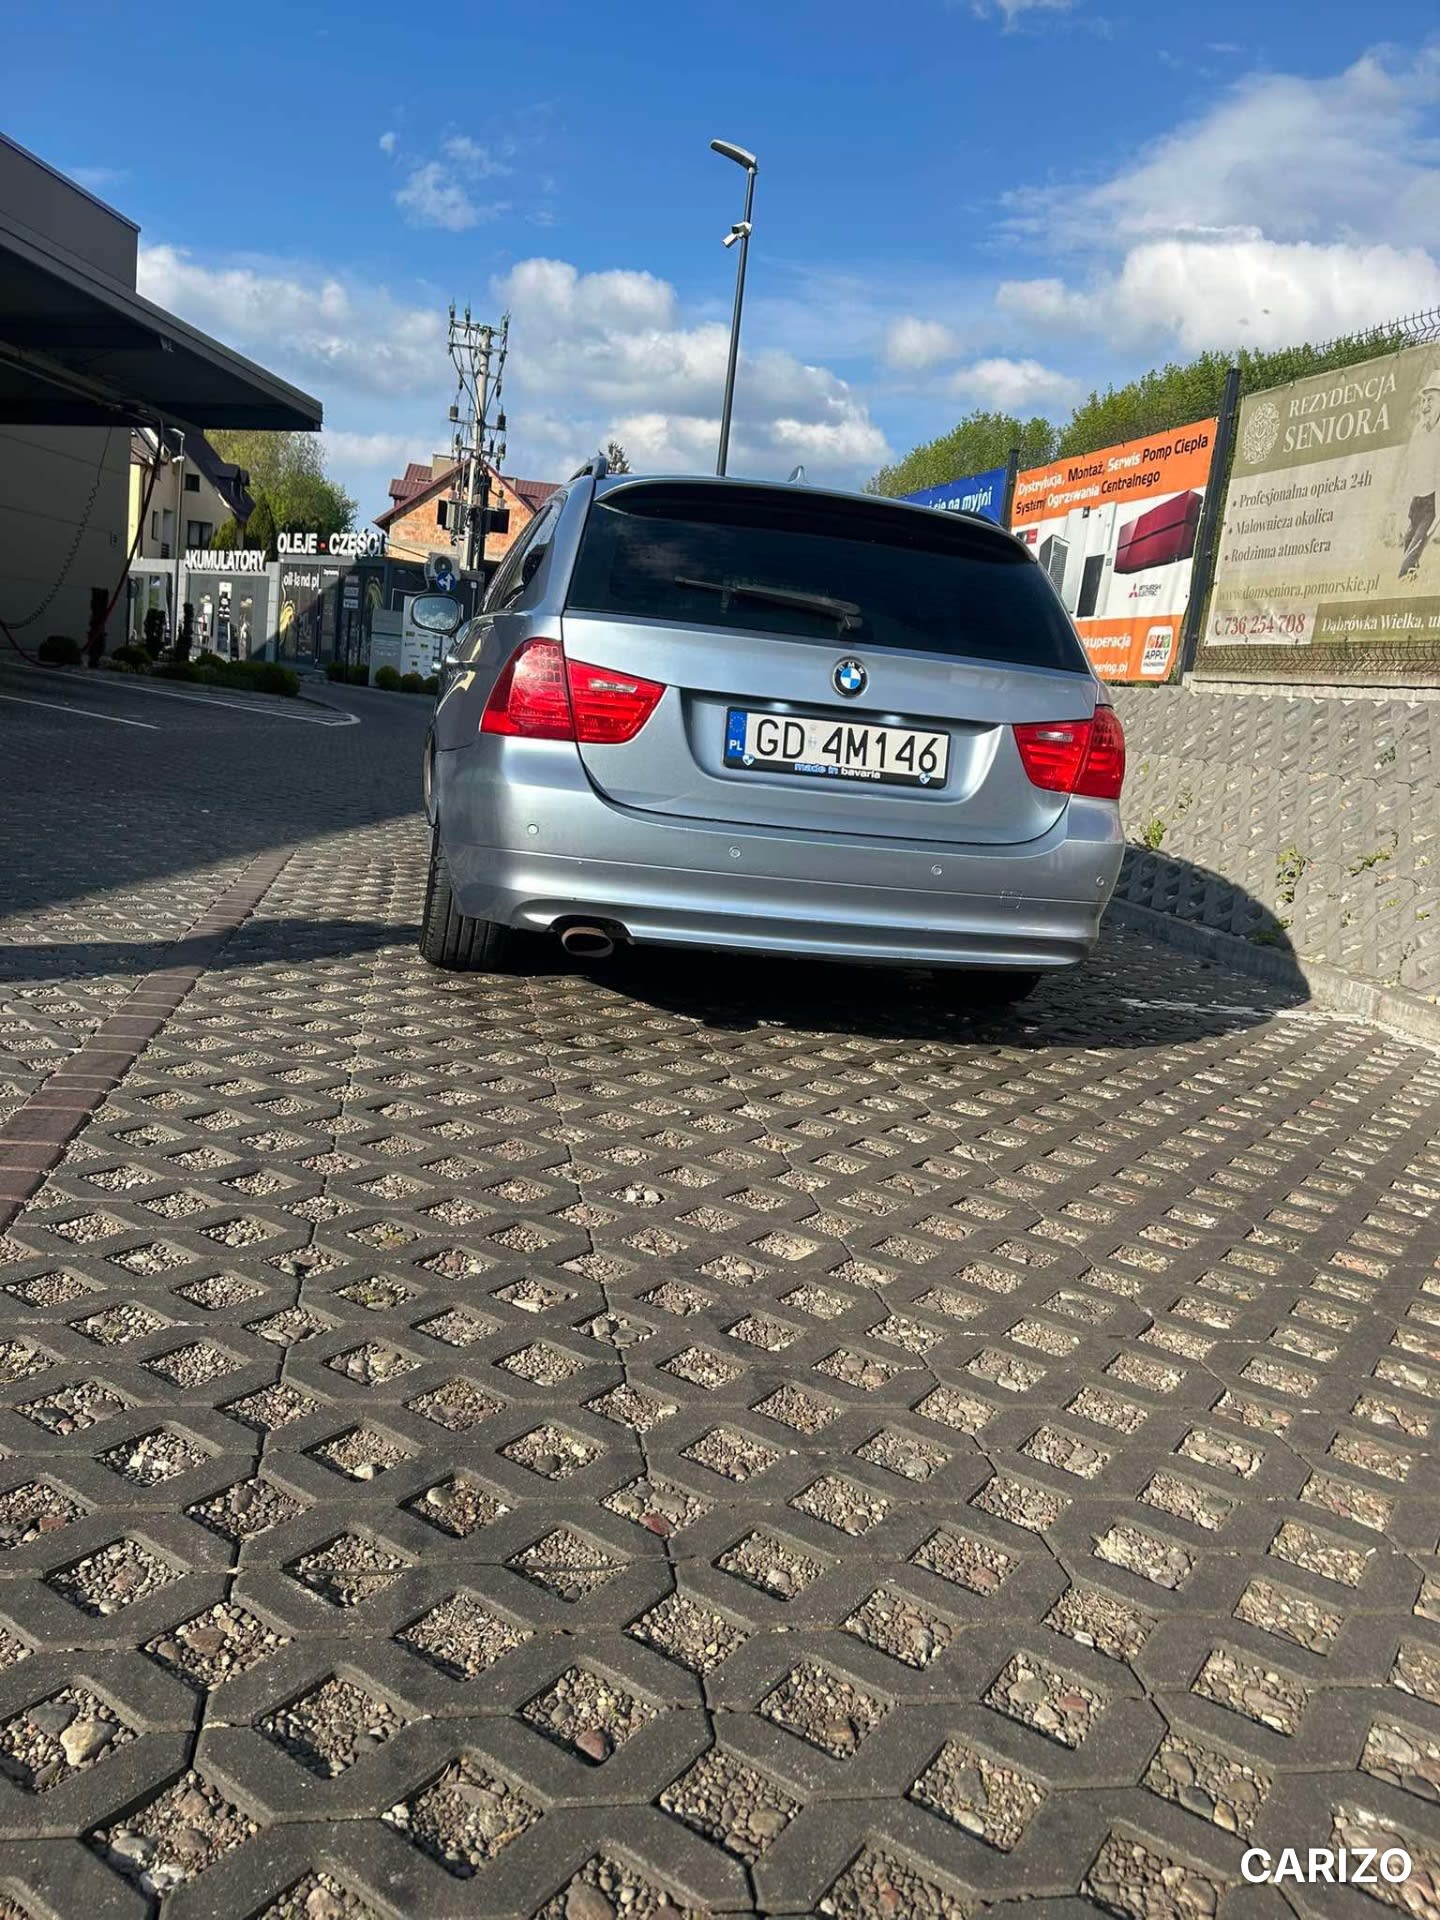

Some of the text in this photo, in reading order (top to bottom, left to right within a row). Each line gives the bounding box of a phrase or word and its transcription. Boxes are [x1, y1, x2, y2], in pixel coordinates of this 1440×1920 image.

[1289, 373, 1397, 418] REZYDENCJA
[1283, 403, 1390, 453] SENIORA
[1107, 453, 1141, 473] Serwis
[1142, 446, 1172, 464] Pomp
[1174, 434, 1209, 457] Ciepła
[962, 486, 992, 512] myjni
[1047, 485, 1100, 508] Ogrzewania
[1101, 470, 1161, 495] Centralnego
[1239, 470, 1373, 509] Profesjonalna opieka 24h
[1236, 508, 1334, 535] Malownicza okolica
[277, 528, 384, 560] OLEJE CZĘŚCI
[1231, 538, 1331, 562] Rodzinna atmosfera
[184, 549, 266, 571] AKUMULATORY
[1225, 614, 1306, 635] 736 254 708
[1321, 614, 1377, 634] Dąbrówka
[1380, 613, 1424, 630] Wielka,
[1144, 649, 1169, 660] APPLY
[729, 740, 743, 751] PL
[756, 718, 939, 773] GD 4M146
[794, 763, 881, 779] made in bavaria
